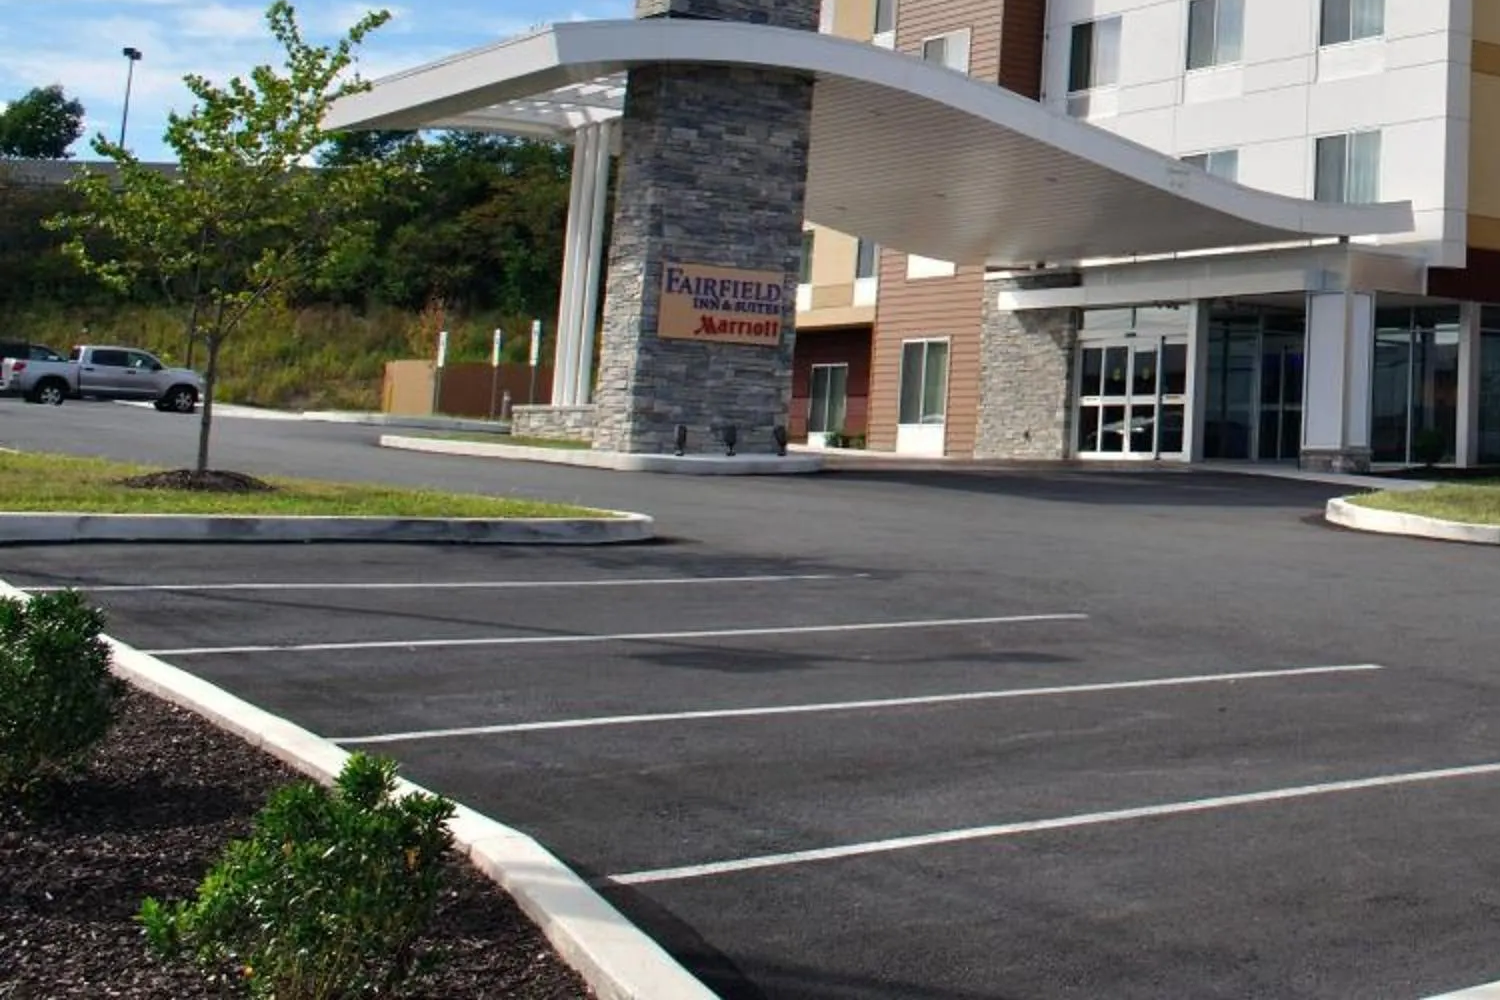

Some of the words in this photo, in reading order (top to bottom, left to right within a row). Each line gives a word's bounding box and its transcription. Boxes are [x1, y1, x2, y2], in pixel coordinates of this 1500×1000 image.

[665, 267, 781, 302] FAIRFIELD
[693, 297, 720, 311] INN
[734, 301, 780, 315] SUITES
[693, 314, 779, 337] Marriott
